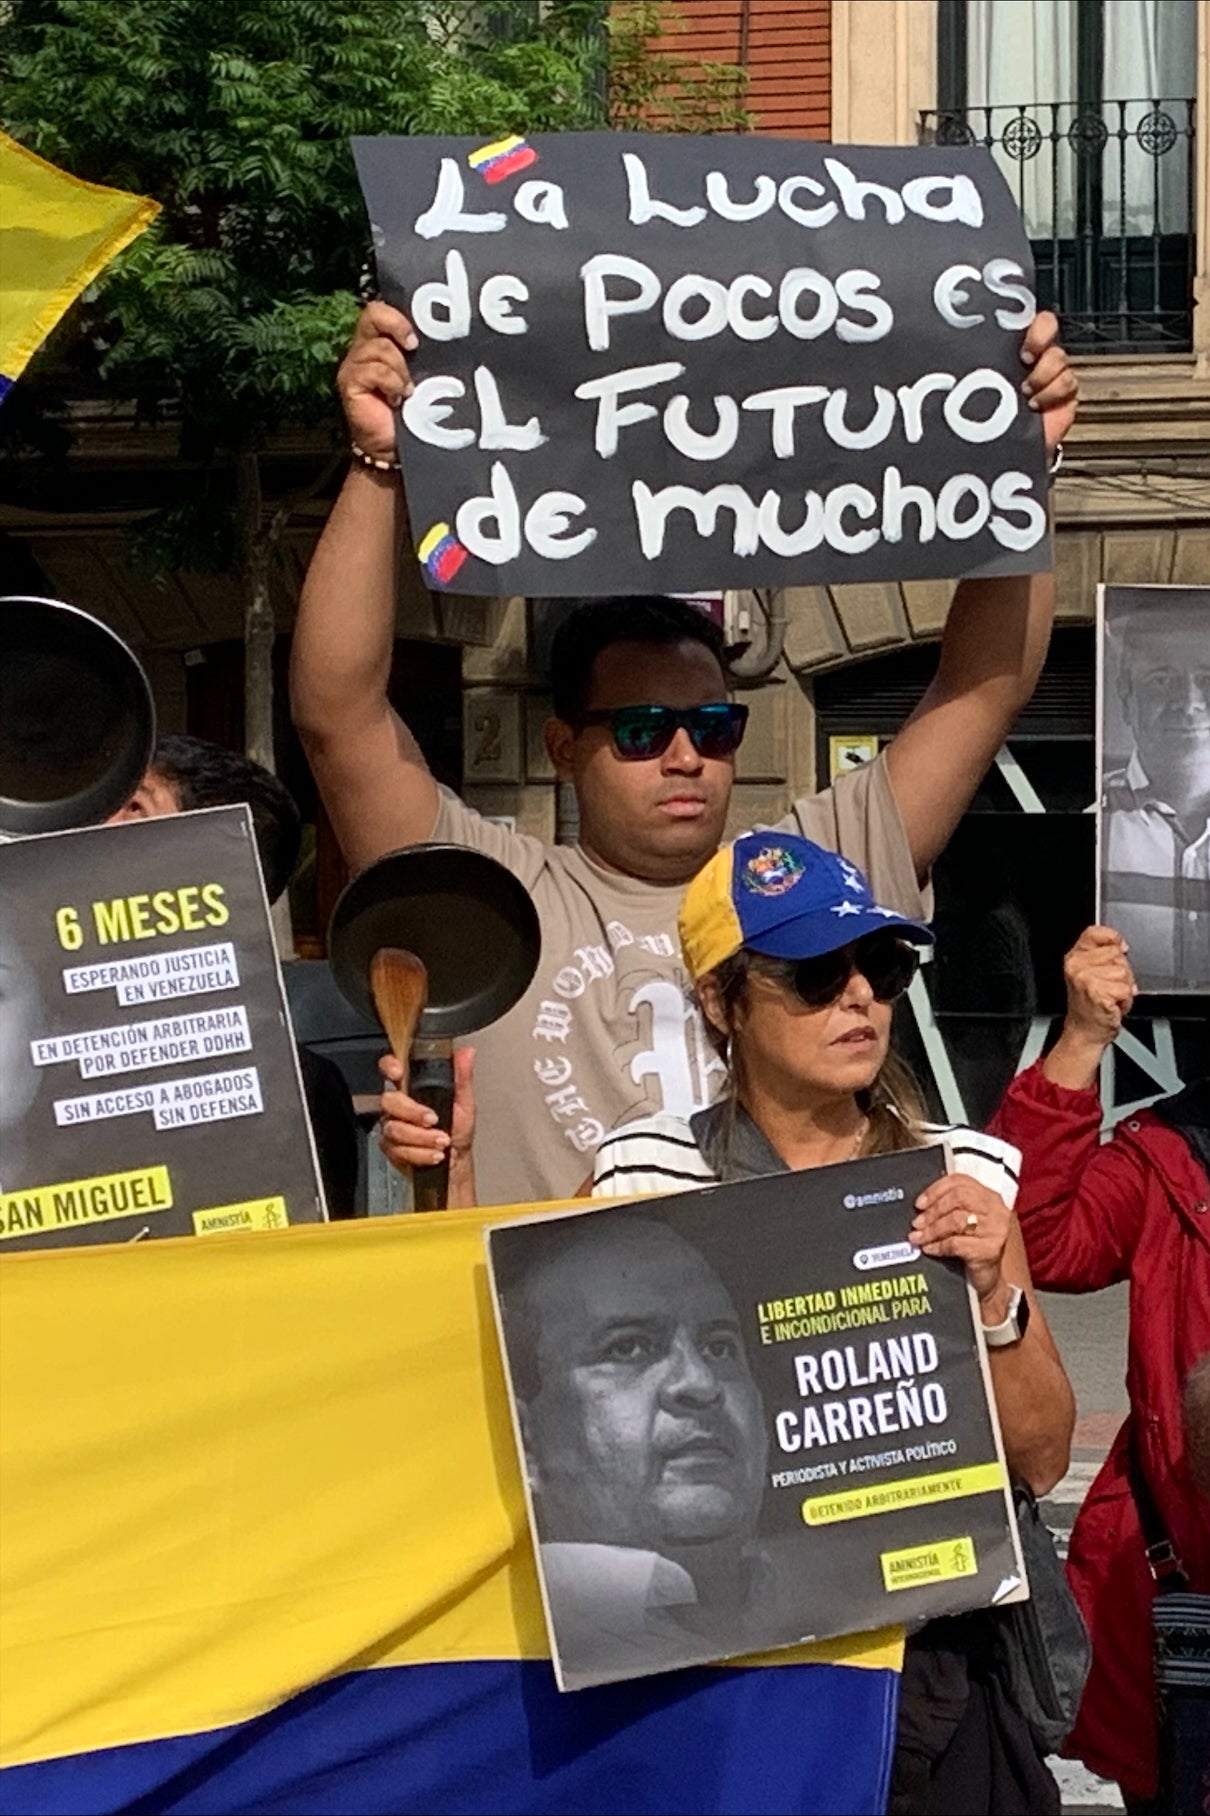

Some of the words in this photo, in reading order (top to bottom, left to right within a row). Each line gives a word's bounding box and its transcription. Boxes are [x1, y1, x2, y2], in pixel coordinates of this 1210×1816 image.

[414, 158, 569, 239] La
[622, 153, 984, 228] Lucha
[411, 249, 530, 341] de
[455, 460, 598, 564] de
[56, 907, 84, 950] 6
[93, 883, 230, 945] MESES
[70, 961, 161, 989] ESPERANDO
[165, 949, 230, 974] JUSTICIA
[125, 985, 144, 1003] EN
[149, 969, 235, 997] VENEZUELA
[38, 1042, 58, 1060] EN
[62, 1024, 149, 1057] DETENCIÓN
[153, 1010, 243, 1040] ARBITRARIA
[83, 1053, 117, 1074] POR
[121, 1040, 200, 1068] DEFENDER
[204, 1031, 246, 1053] DDHH
[64, 1101, 91, 1121] SIN
[95, 1091, 155, 1116] ACCESO
[160, 1088, 170, 1104] A
[174, 1073, 254, 1102] ABOGADOS
[159, 1106, 186, 1126] SIN
[190, 1095, 259, 1120] DEFENSA
[52, 1176, 166, 1224] MIGUEL
[758, 1291, 837, 1323] LIBERTAD
[840, 1273, 929, 1307] INMEDIATA
[760, 1326, 773, 1344] E
[774, 1305, 891, 1342] INCONDICIONAL
[891, 1296, 933, 1320] PARA
[794, 1332, 939, 1397] ROLAND
[775, 1379, 948, 1453] CARREÑO
[771, 1466, 839, 1488] PERIODISTA
[839, 1462, 848, 1474] Y
[849, 1450, 905, 1473] ACTIVISTA
[906, 1439, 957, 1461] POLÍTICO
[809, 1498, 863, 1519] DETENIDO
[865, 1479, 963, 1508] ARBITRARIAMENTE
